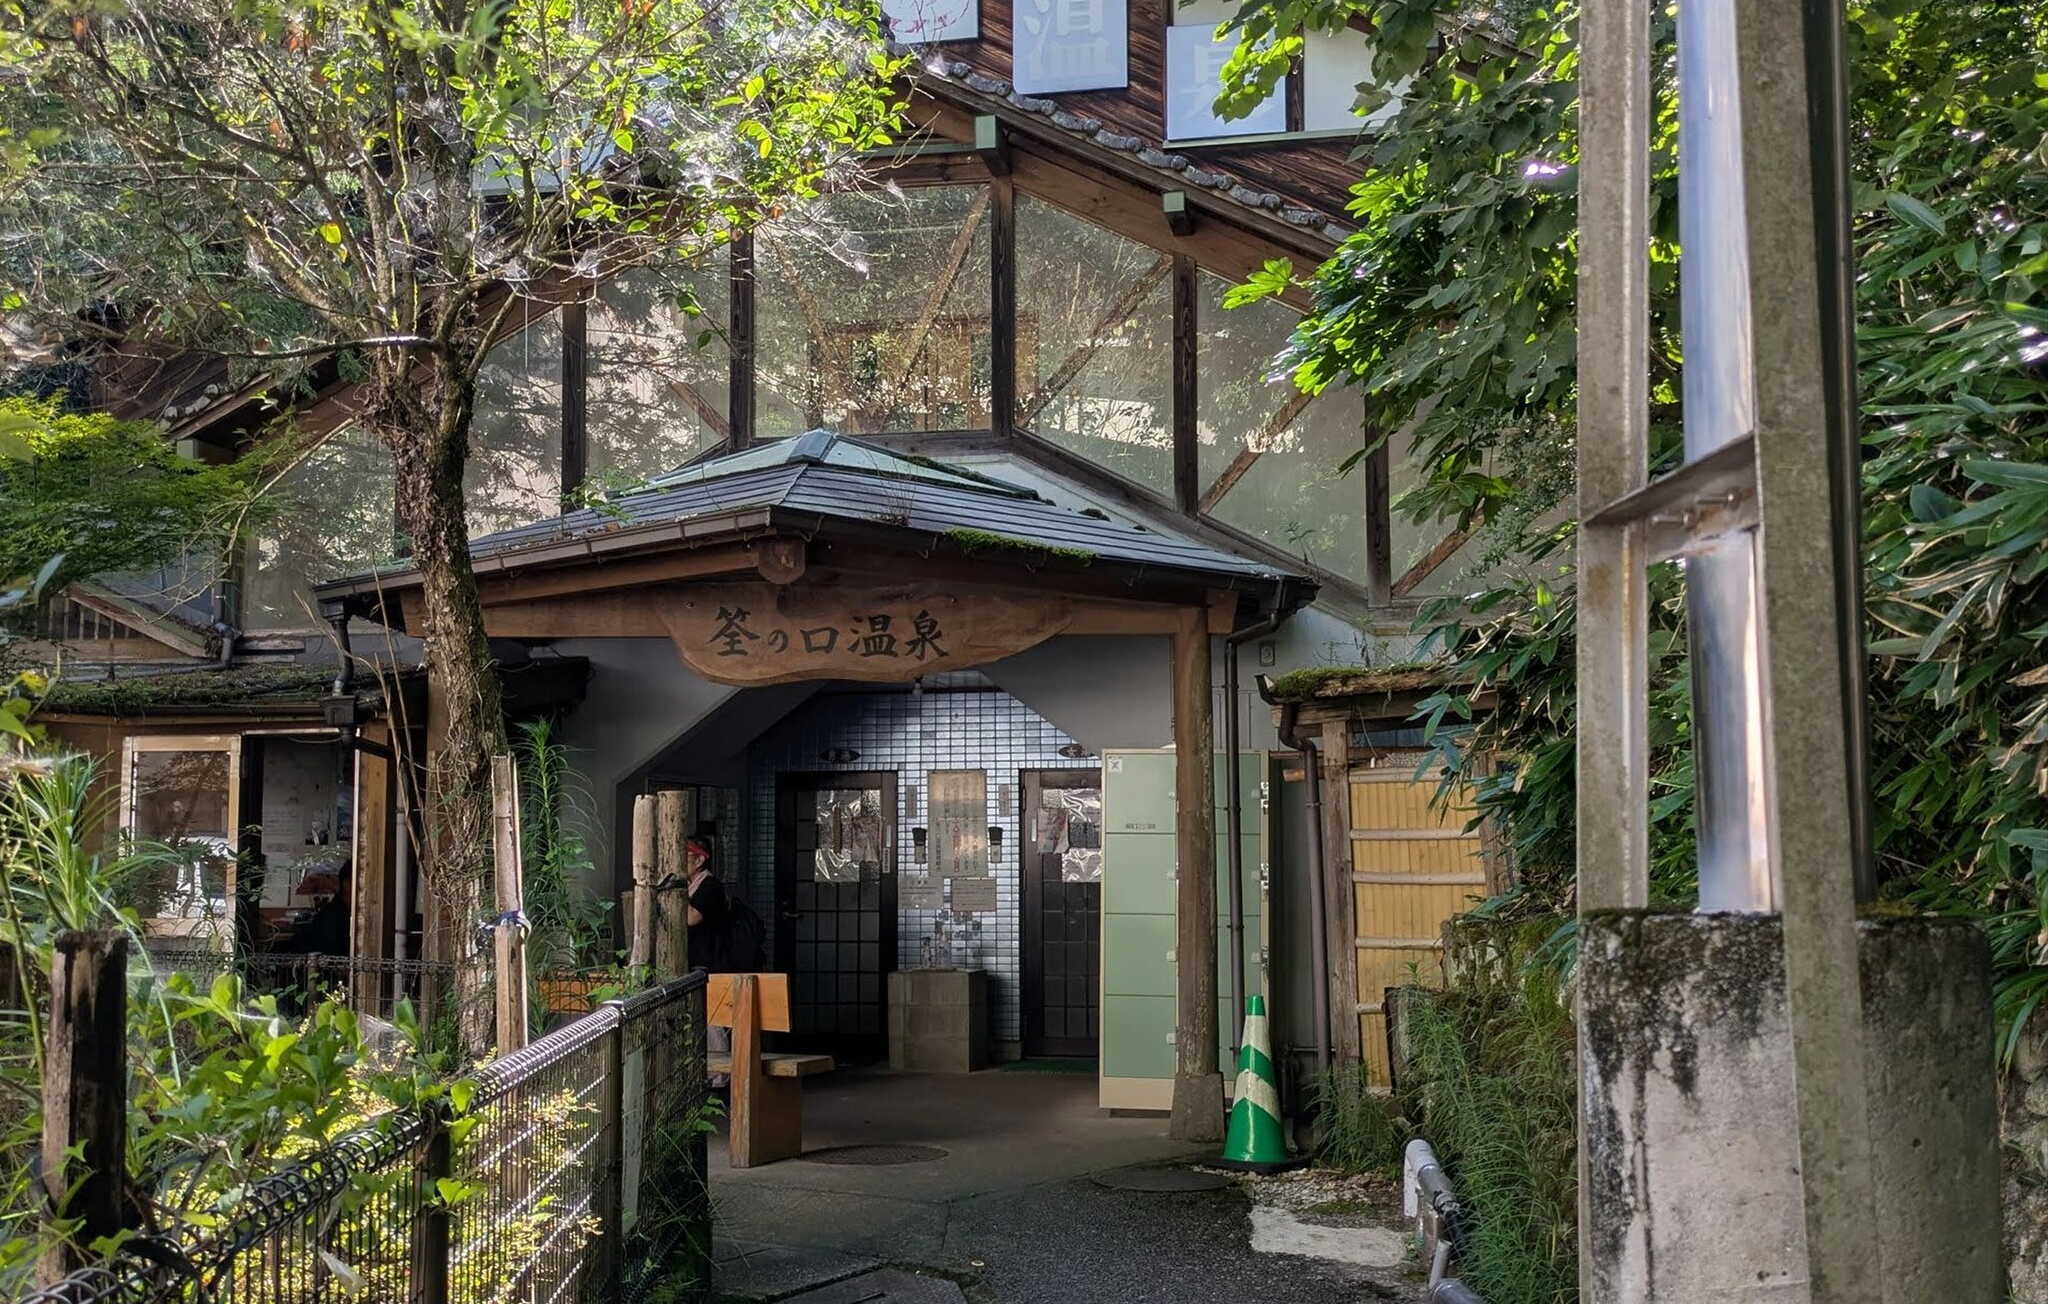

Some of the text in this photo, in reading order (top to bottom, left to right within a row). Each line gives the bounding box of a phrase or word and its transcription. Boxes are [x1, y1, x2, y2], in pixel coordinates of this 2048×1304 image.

[705, 606, 949, 661] 筌の口温泉
